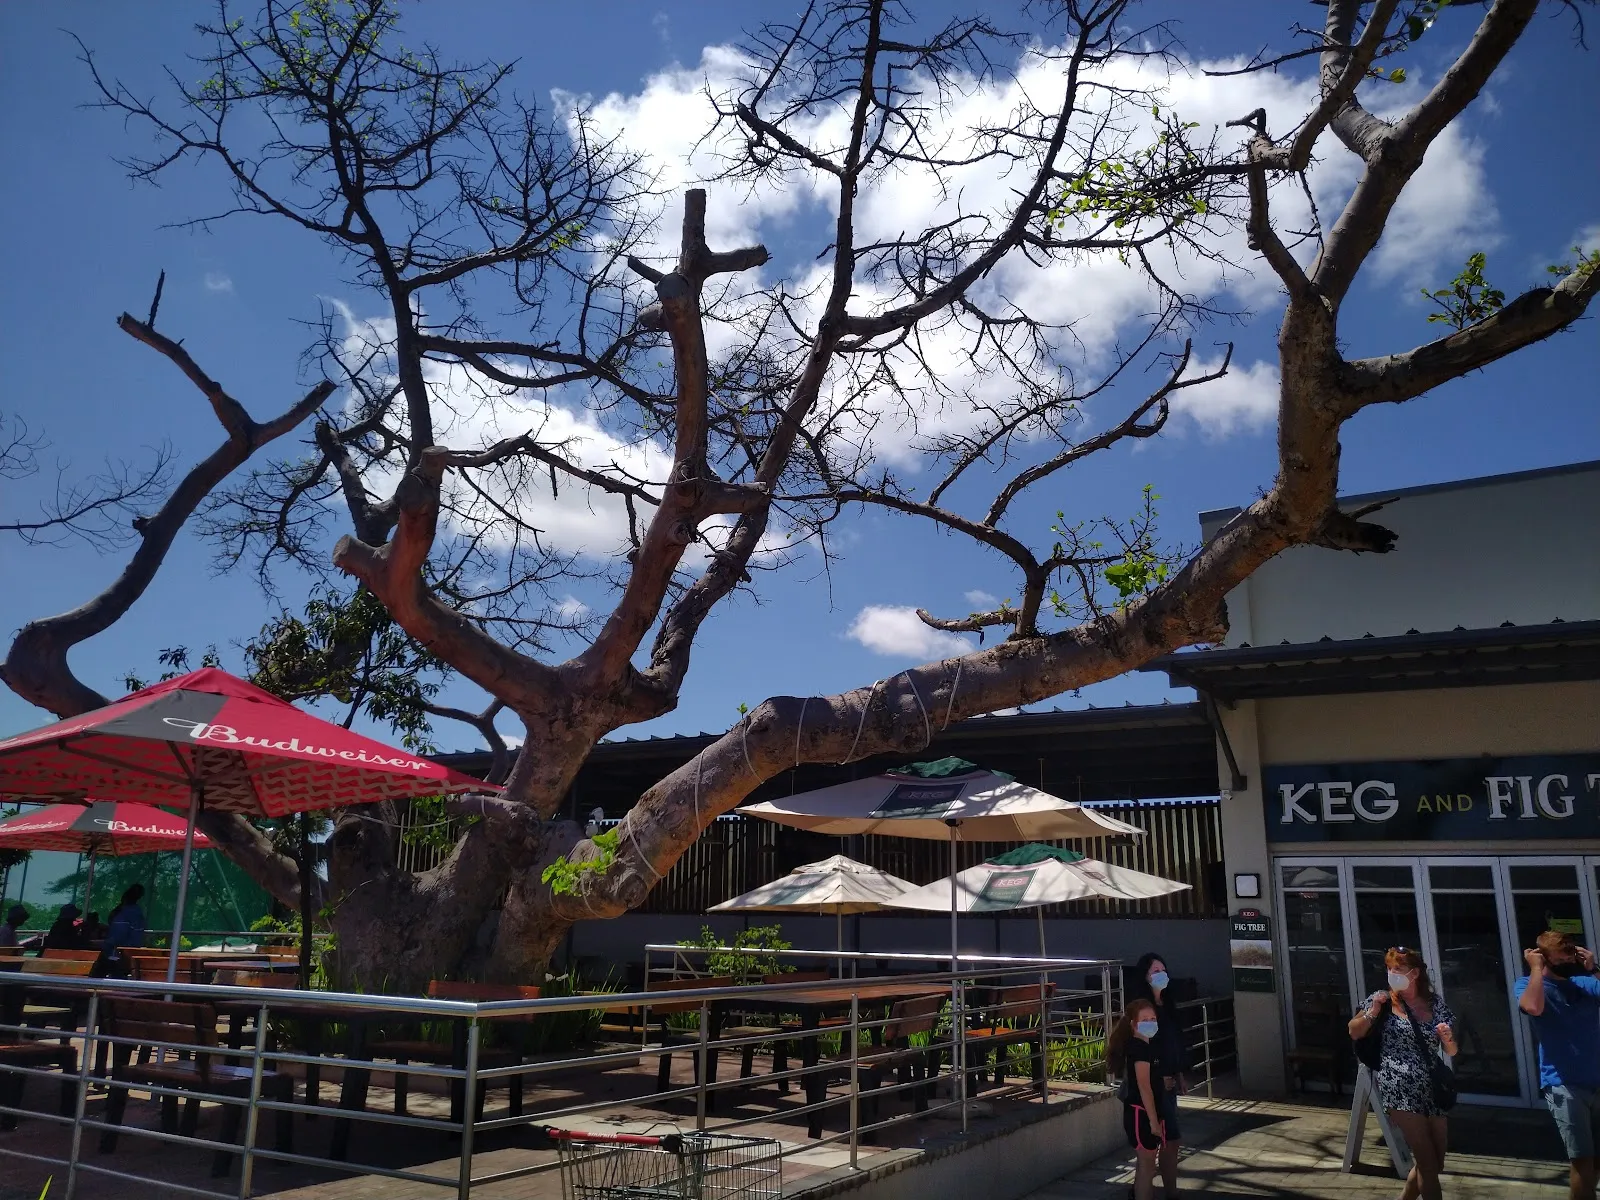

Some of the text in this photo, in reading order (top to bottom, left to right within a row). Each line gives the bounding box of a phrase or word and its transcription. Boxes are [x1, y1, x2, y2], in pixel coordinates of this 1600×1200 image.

[162, 717, 431, 770] Budweiser
[1278, 780, 1399, 824] KEG
[1416, 794, 1473, 813] AND
[1483, 774, 1576, 820] FIG
[996, 877, 1024, 886] KEG
[1234, 923, 1266, 931] FIG TREE
